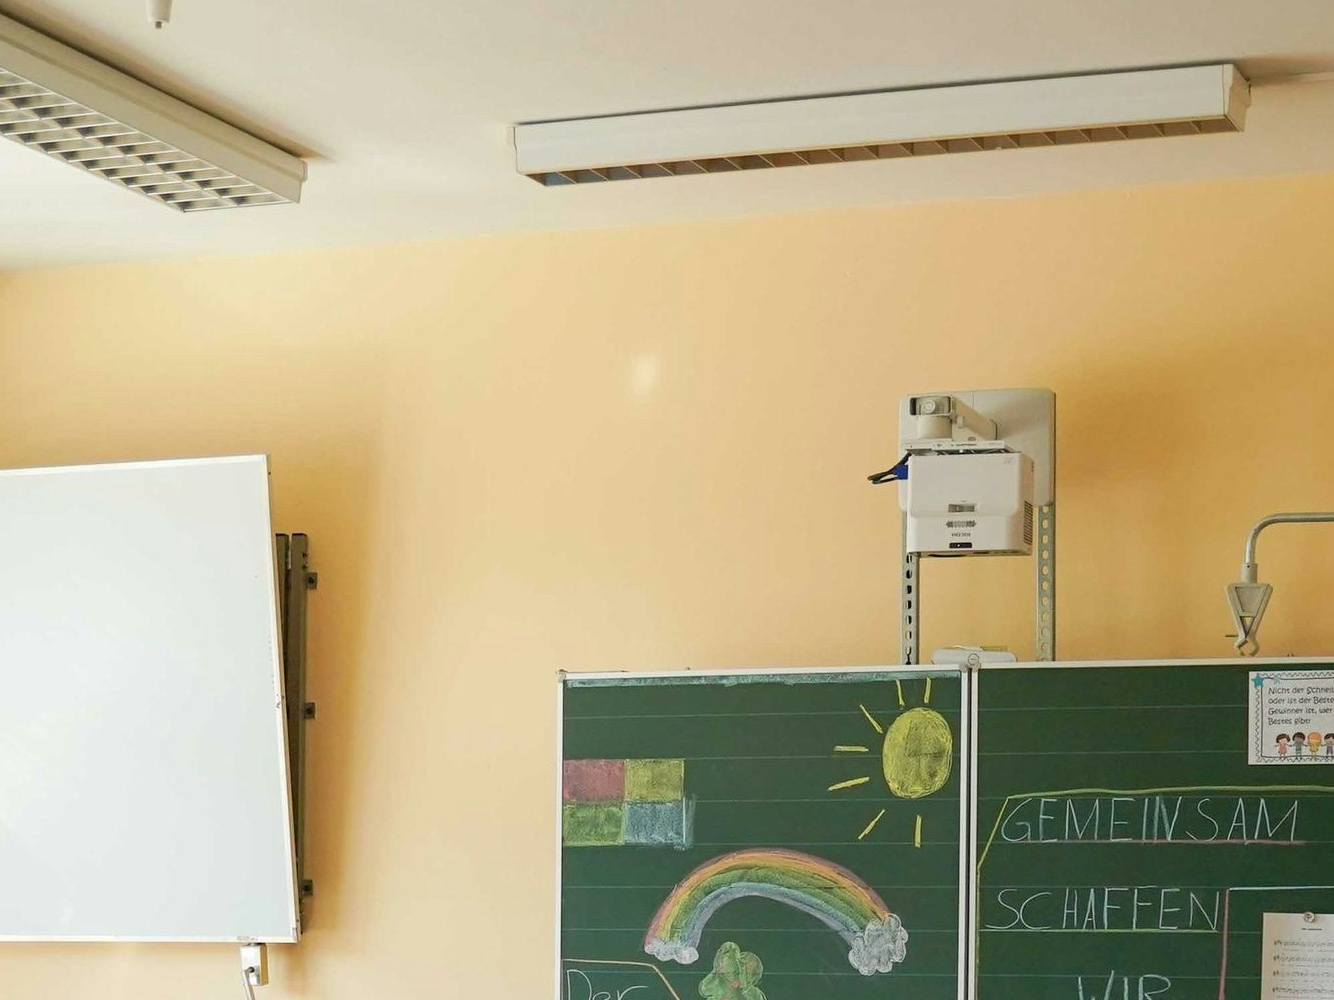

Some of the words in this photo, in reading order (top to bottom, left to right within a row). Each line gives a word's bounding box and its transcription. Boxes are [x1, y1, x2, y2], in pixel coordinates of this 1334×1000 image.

[1268, 686, 1291, 695] Nicht
[1292, 686, 1305, 694] der
[1268, 697, 1285, 705] oder
[1268, 707, 1303, 716] Gewinner
[1267, 717, 1292, 726] Bestes
[1001, 796, 1298, 843] GEMEINSAM
[985, 886, 1220, 931] SCHAFFEN
